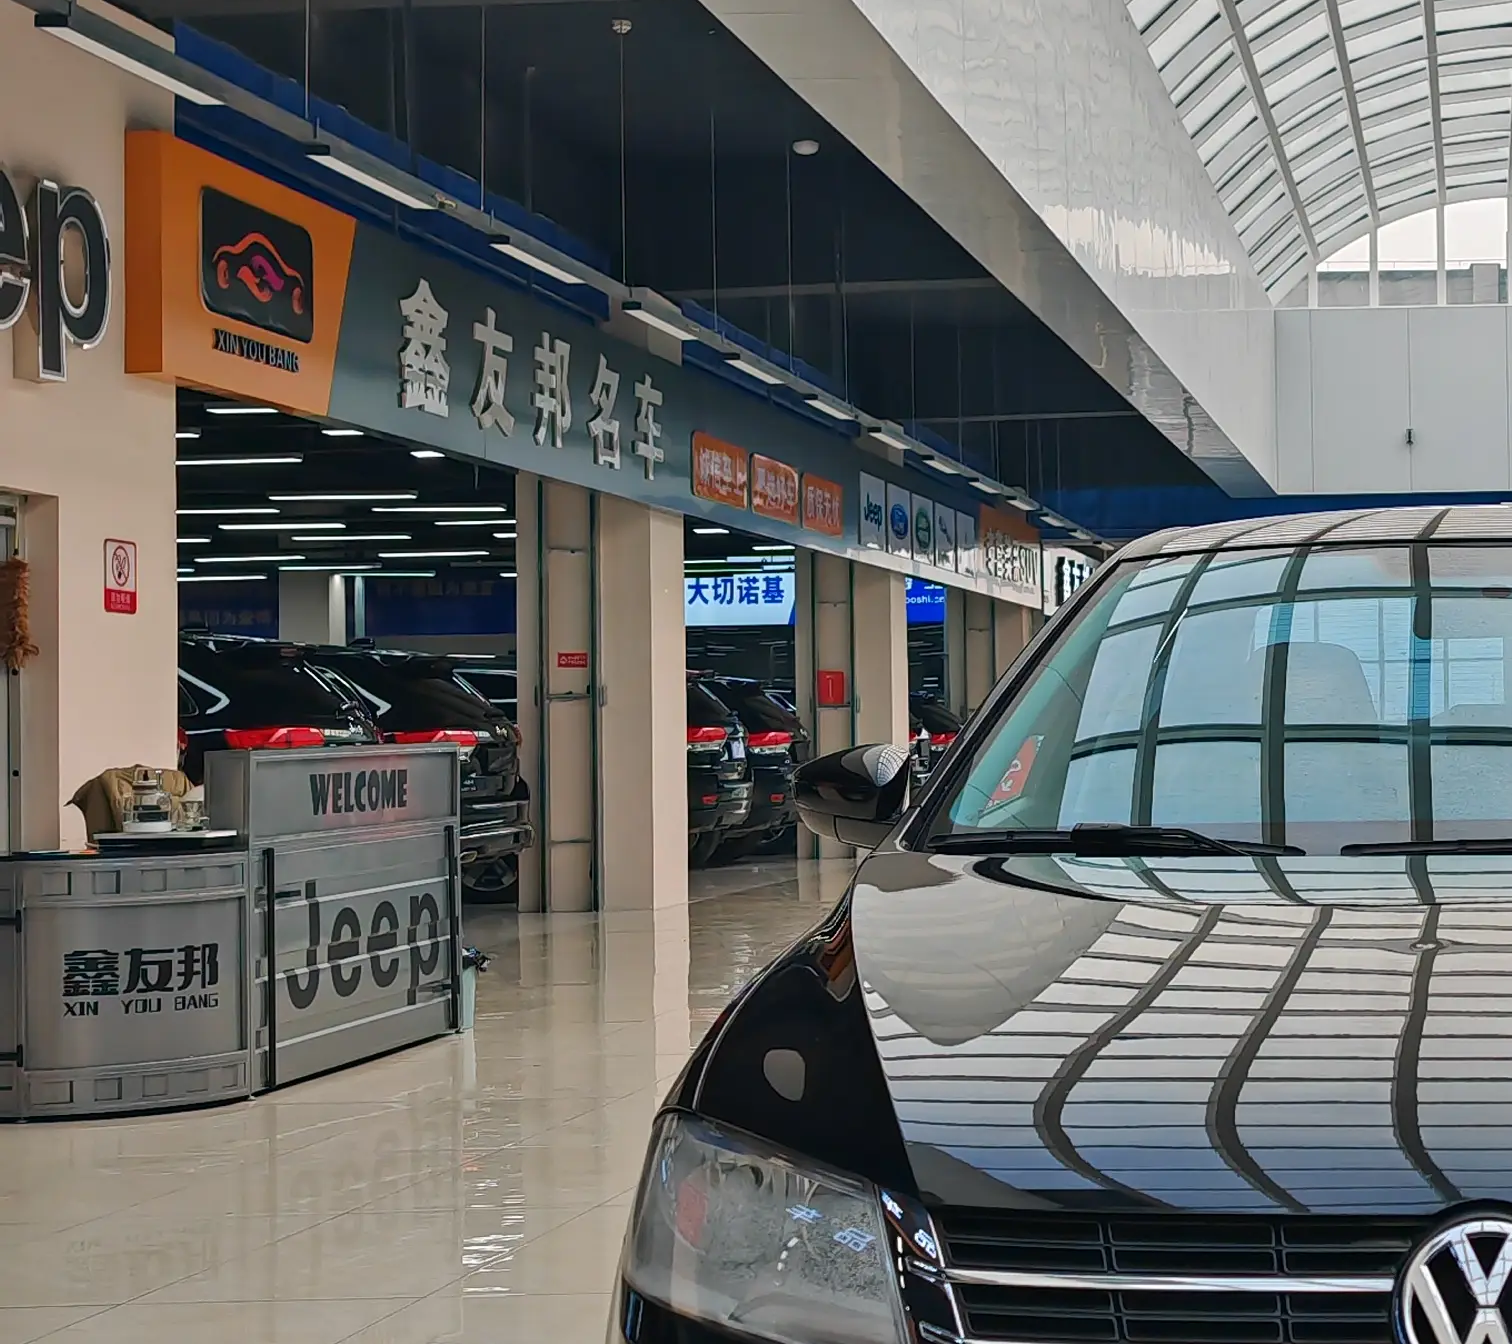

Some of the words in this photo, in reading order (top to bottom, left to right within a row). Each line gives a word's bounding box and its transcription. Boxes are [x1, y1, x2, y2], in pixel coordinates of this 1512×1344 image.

[218, 330, 239, 354] XIN
[242, 339, 266, 364] YOU
[399, 277, 665, 481] 鑫友邦名车
[864, 491, 883, 532] Jeep
[687, 575, 784, 605] 大切诺基
[309, 769, 408, 816] WELCOME
[283, 879, 440, 1009] Jeep
[62, 943, 219, 997] 鑫友邦
[63, 1001, 99, 1017] XIN
[121, 998, 162, 1014] YOU
[174, 993, 219, 1011] BANG
